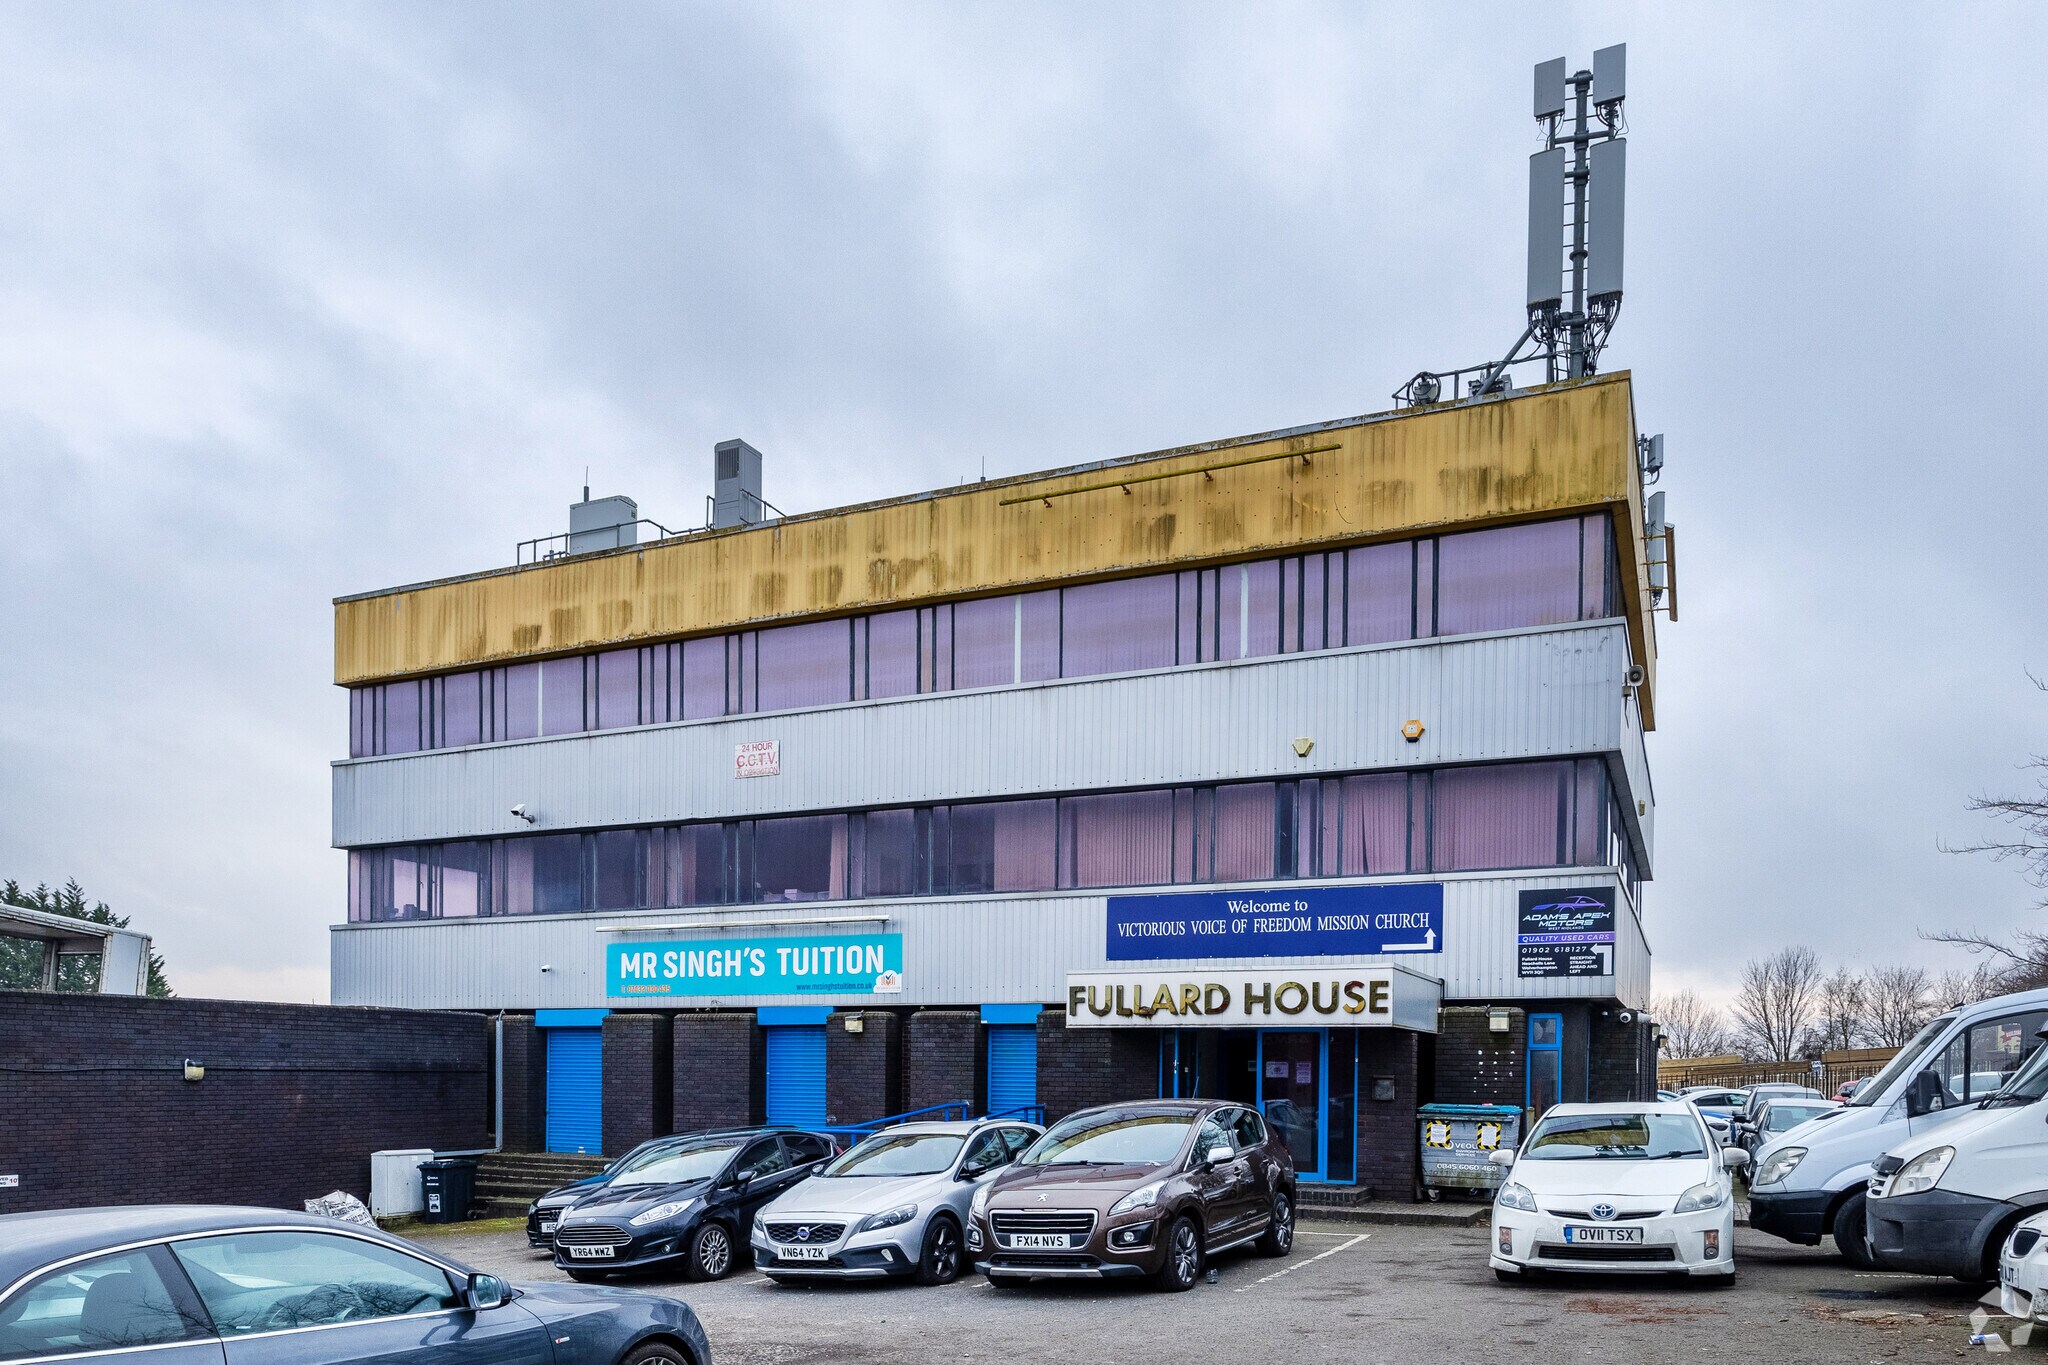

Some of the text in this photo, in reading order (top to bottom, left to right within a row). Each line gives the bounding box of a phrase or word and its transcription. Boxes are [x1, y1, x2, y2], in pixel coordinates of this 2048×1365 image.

[742, 742, 772, 752] 24 HOUR
[1227, 900, 1308, 914] Welcome to
[1573, 912, 1611, 920] APEX
[1118, 912, 1429, 936] VICTORIOUS VOICE OF FREEDOM MISSION CHURCH
[620, 944, 884, 978] MR SINGH'S TUITION
[796, 982, 873, 992] www.mrsinghstuition.co.uk
[1069, 980, 1390, 1017] FULLARD HOUSE
[1580, 1229, 1634, 1240] OV11 TSX
[1016, 1236, 1064, 1246] FX14 NVS
[572, 1248, 592, 1257] YR64
[781, 1248, 824, 1258] VN64 YZK
